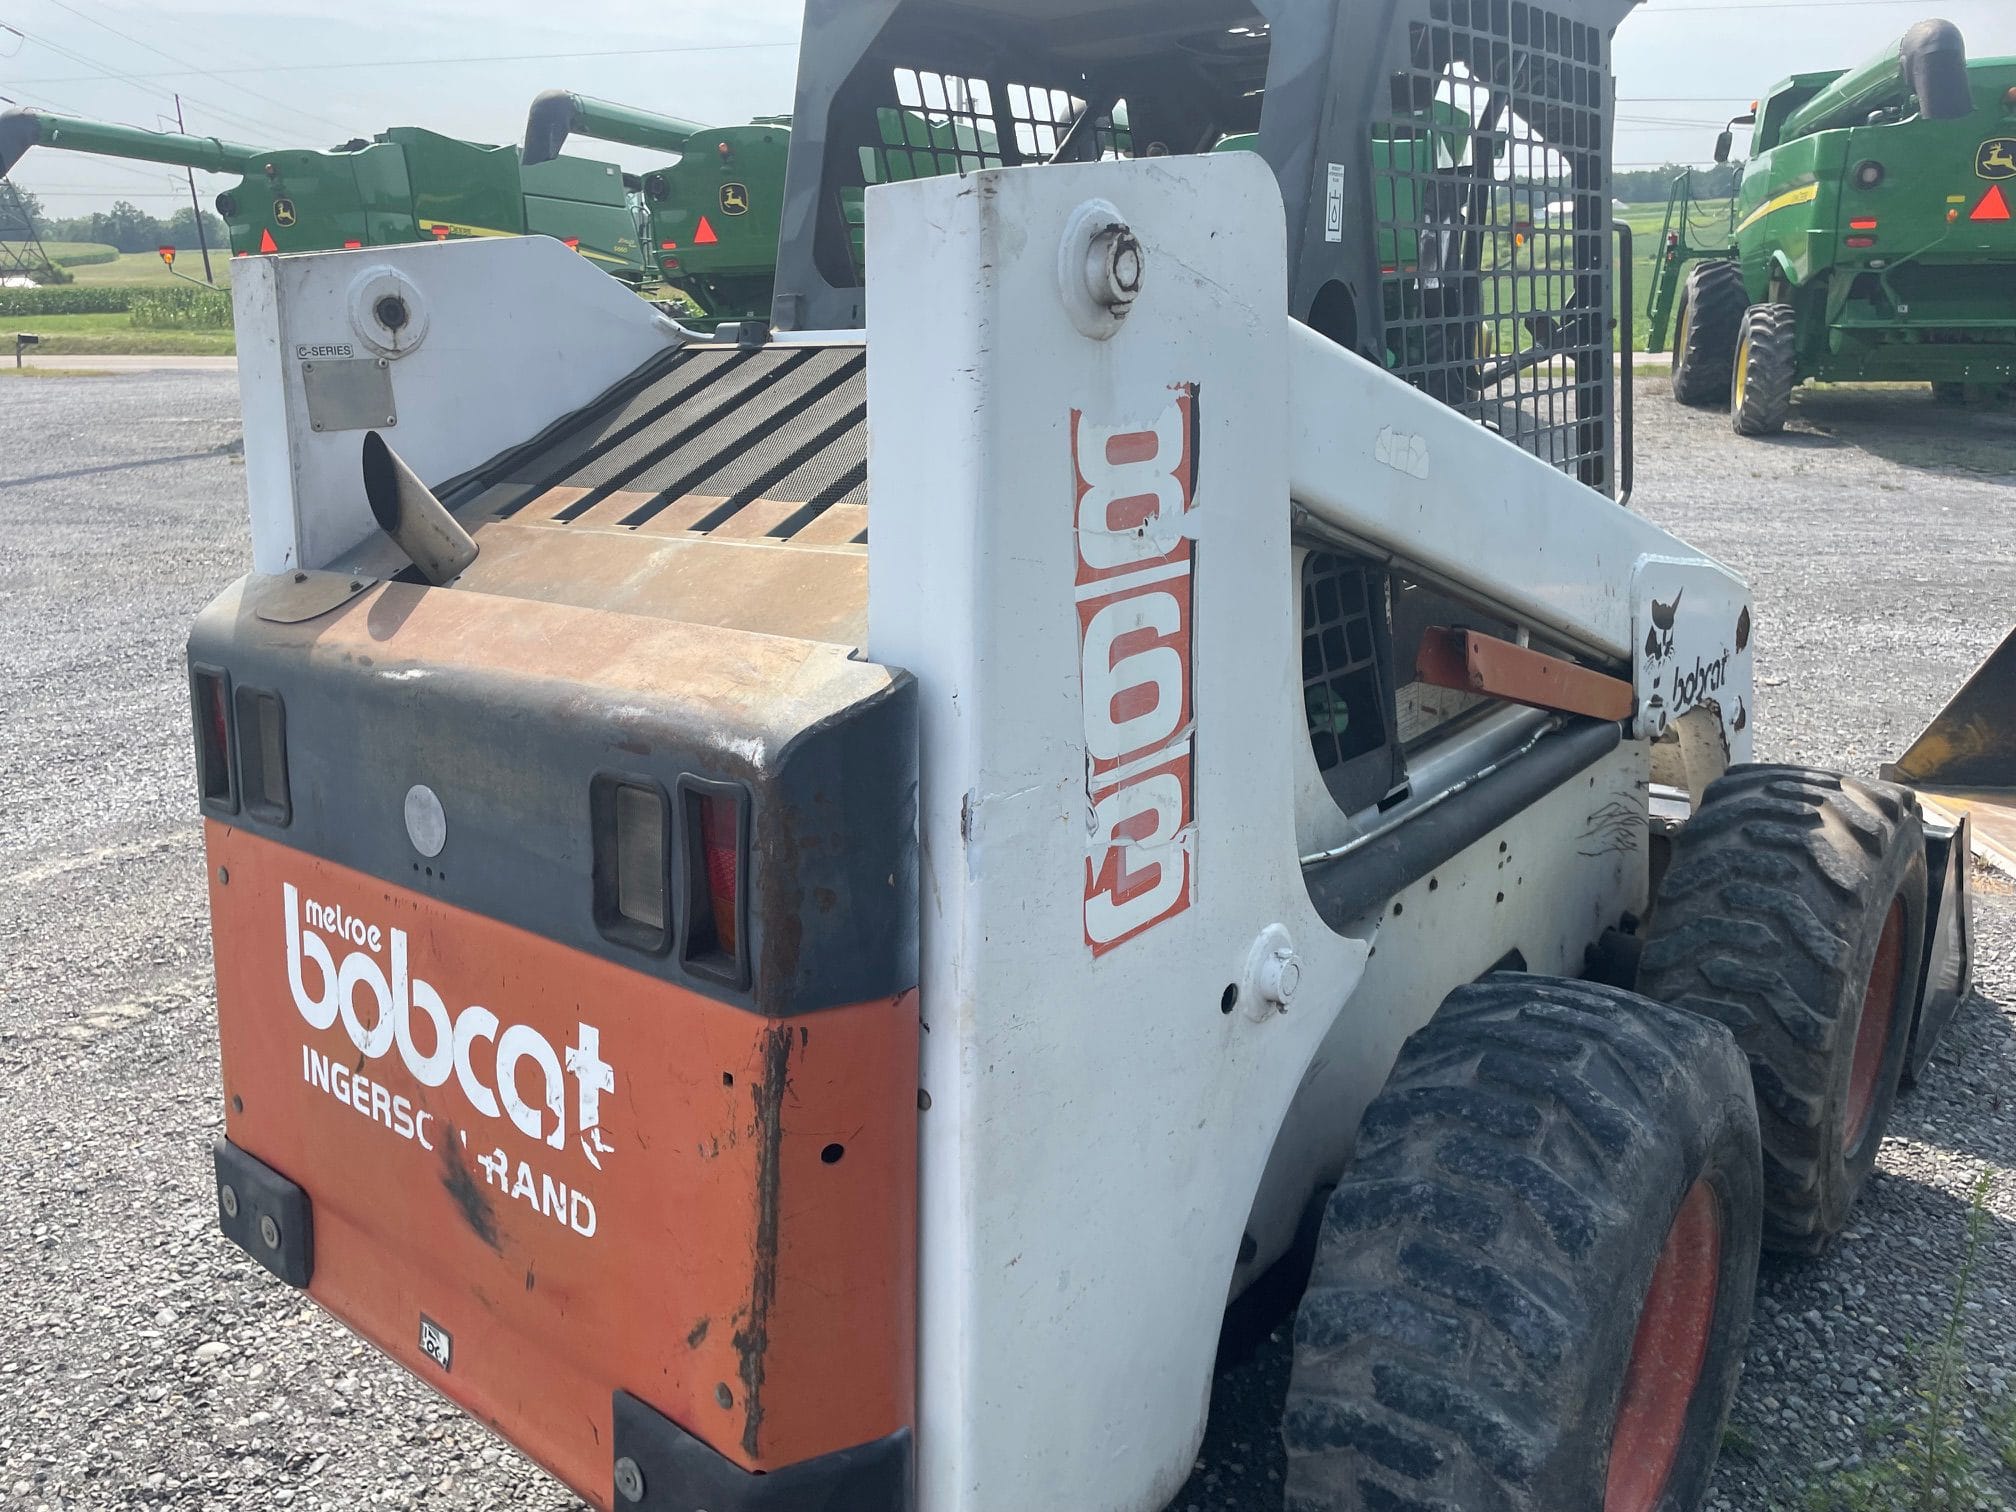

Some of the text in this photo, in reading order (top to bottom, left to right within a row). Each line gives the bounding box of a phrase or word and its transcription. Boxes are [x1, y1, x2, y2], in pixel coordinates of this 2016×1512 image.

[299, 346, 351, 356] C-SERIES
[306, 898, 382, 953] melroe
[283, 882, 615, 1171] bobcat
